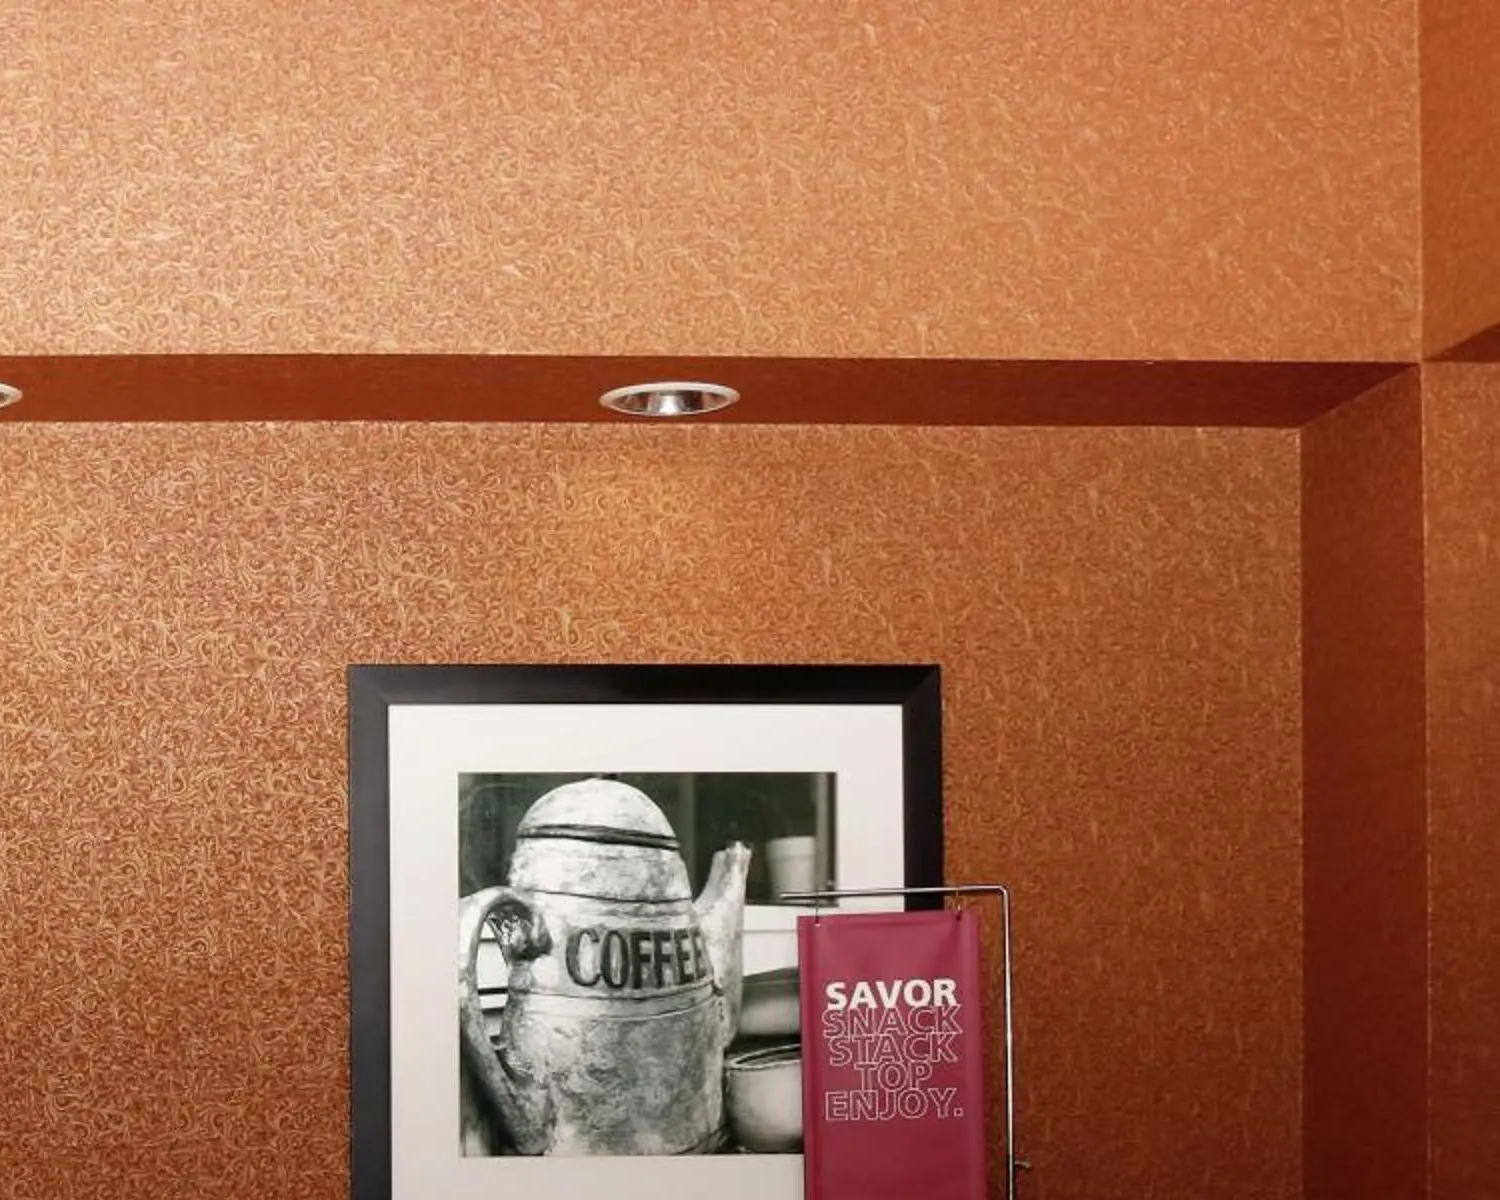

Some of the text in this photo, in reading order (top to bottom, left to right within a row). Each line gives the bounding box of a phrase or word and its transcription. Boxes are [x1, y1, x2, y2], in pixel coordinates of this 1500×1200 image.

[565, 927, 708, 990] COFFEE
[825, 978, 958, 1010] SAVOR
[821, 1003, 963, 1038] SNACK
[828, 1032, 960, 1066] STACK
[854, 1060, 933, 1092] TOP
[825, 1087, 964, 1121] ENJOY.
